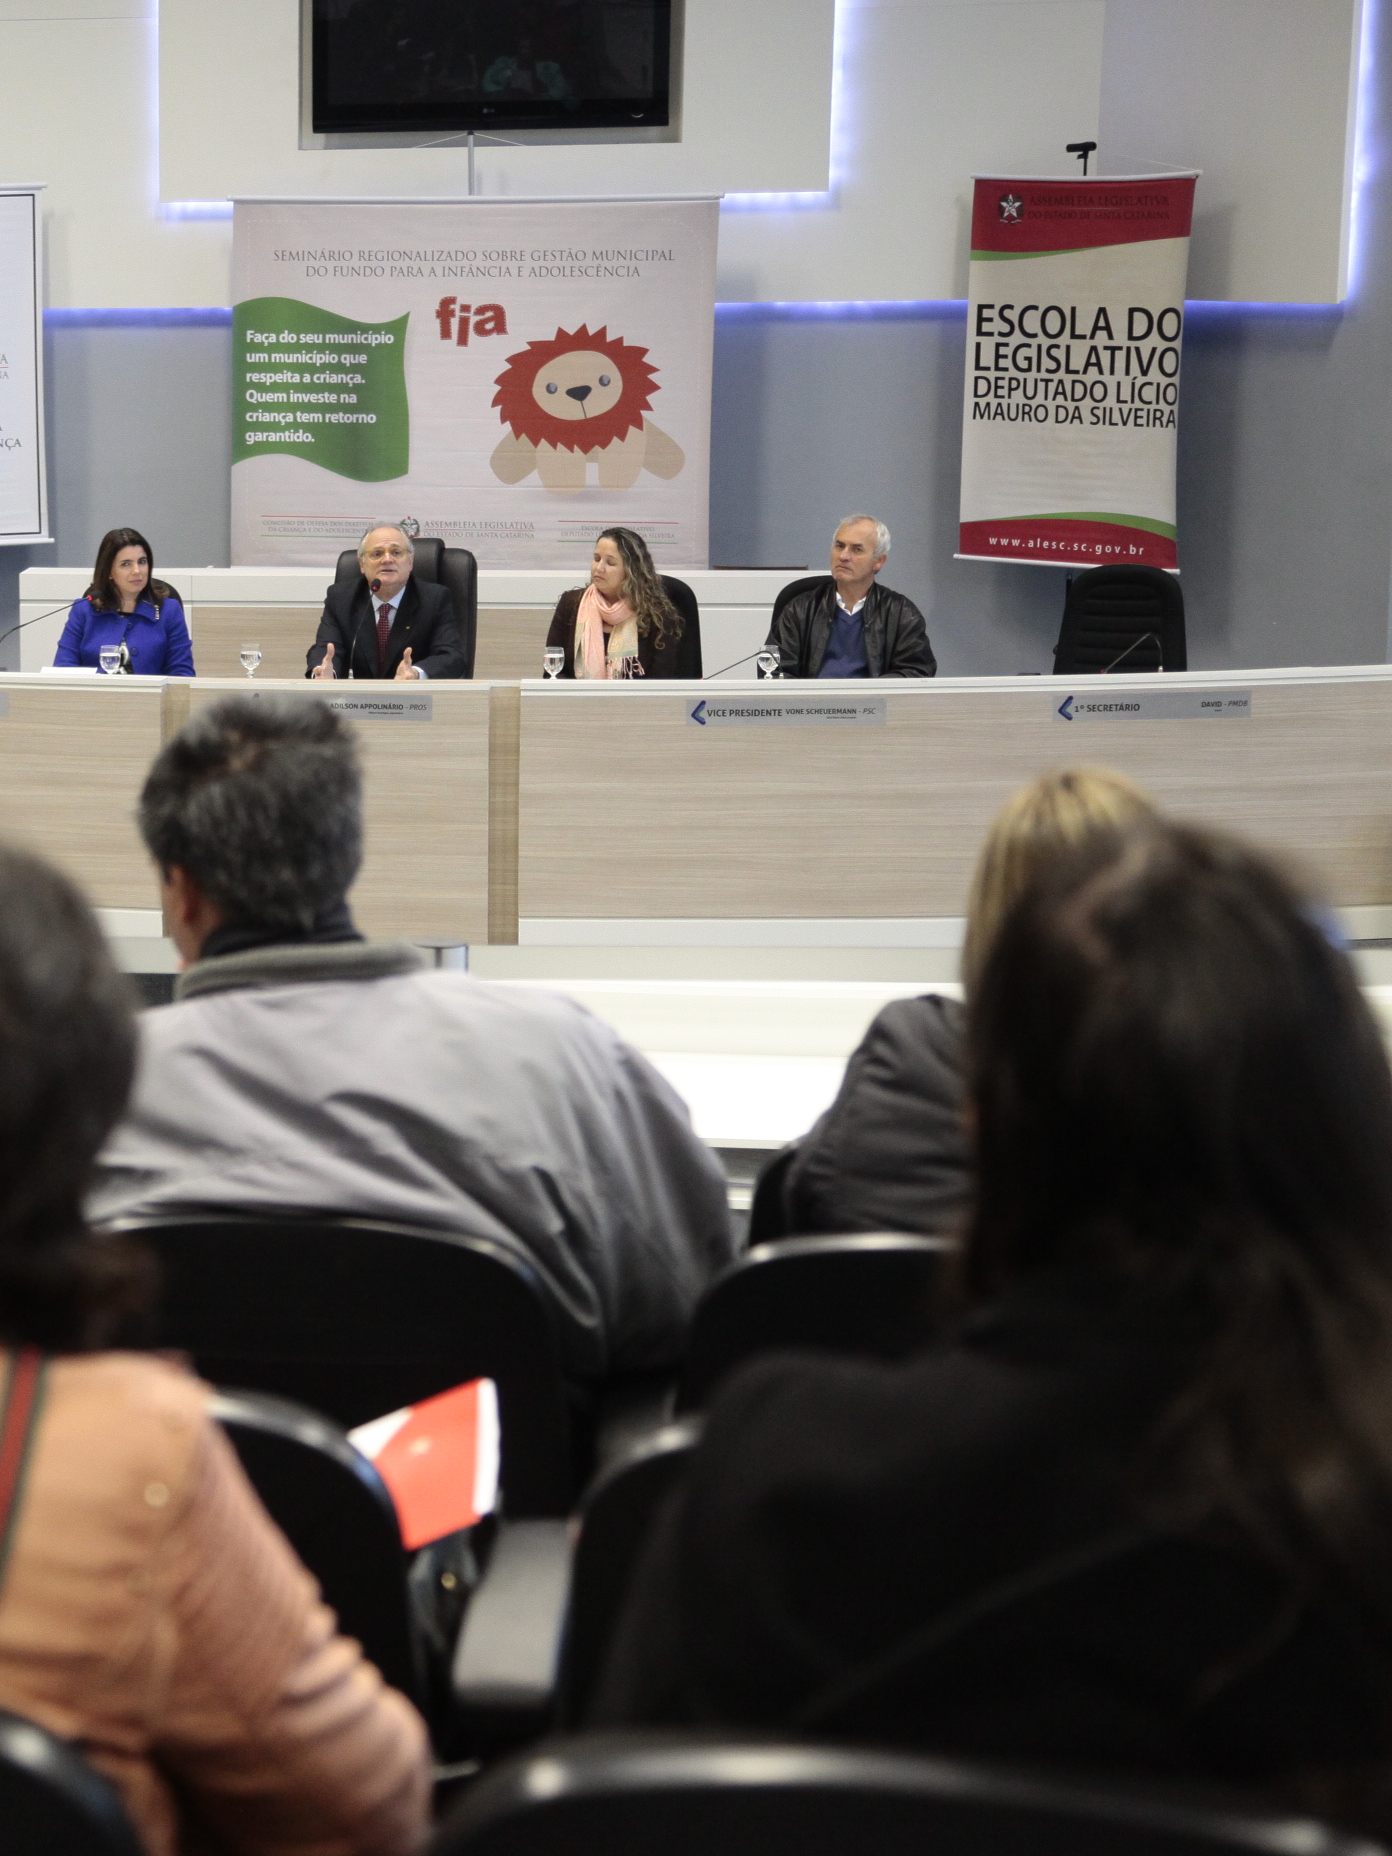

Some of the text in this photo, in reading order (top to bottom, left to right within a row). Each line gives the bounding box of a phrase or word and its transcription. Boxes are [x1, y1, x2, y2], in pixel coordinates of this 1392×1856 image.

[273, 248, 676, 262] SEMINÁRIO REGIONALIZADO SOBRE GESTÃO MUNICIPAL
[306, 264, 640, 278] DO FUNDO PARA A INFÂNCIA E ADOLESCÊNCIA
[976, 304, 1182, 342] ESCOLA DO
[246, 330, 394, 348] Faça do seu município
[246, 350, 368, 367] um município que
[974, 342, 1180, 378] LEGISLATIVO
[246, 370, 366, 387] respeita a criança.
[246, 390, 358, 404] Quem investe na
[973, 376, 1178, 406] DEPUTADO LÍCIO
[246, 410, 376, 426] criança tem retorno
[972, 402, 1176, 428] MAURO DA SILVEIRA
[246, 430, 315, 444] garantido.
[424, 520, 534, 530] ASSEMBLEIA LEGISLATIVA
[989, 537, 1144, 555] www.alesc.sc.gov.br
[707, 708, 783, 717] VICE PRESIDENTE
[1086, 703, 1141, 713] SECRETÁRIO
